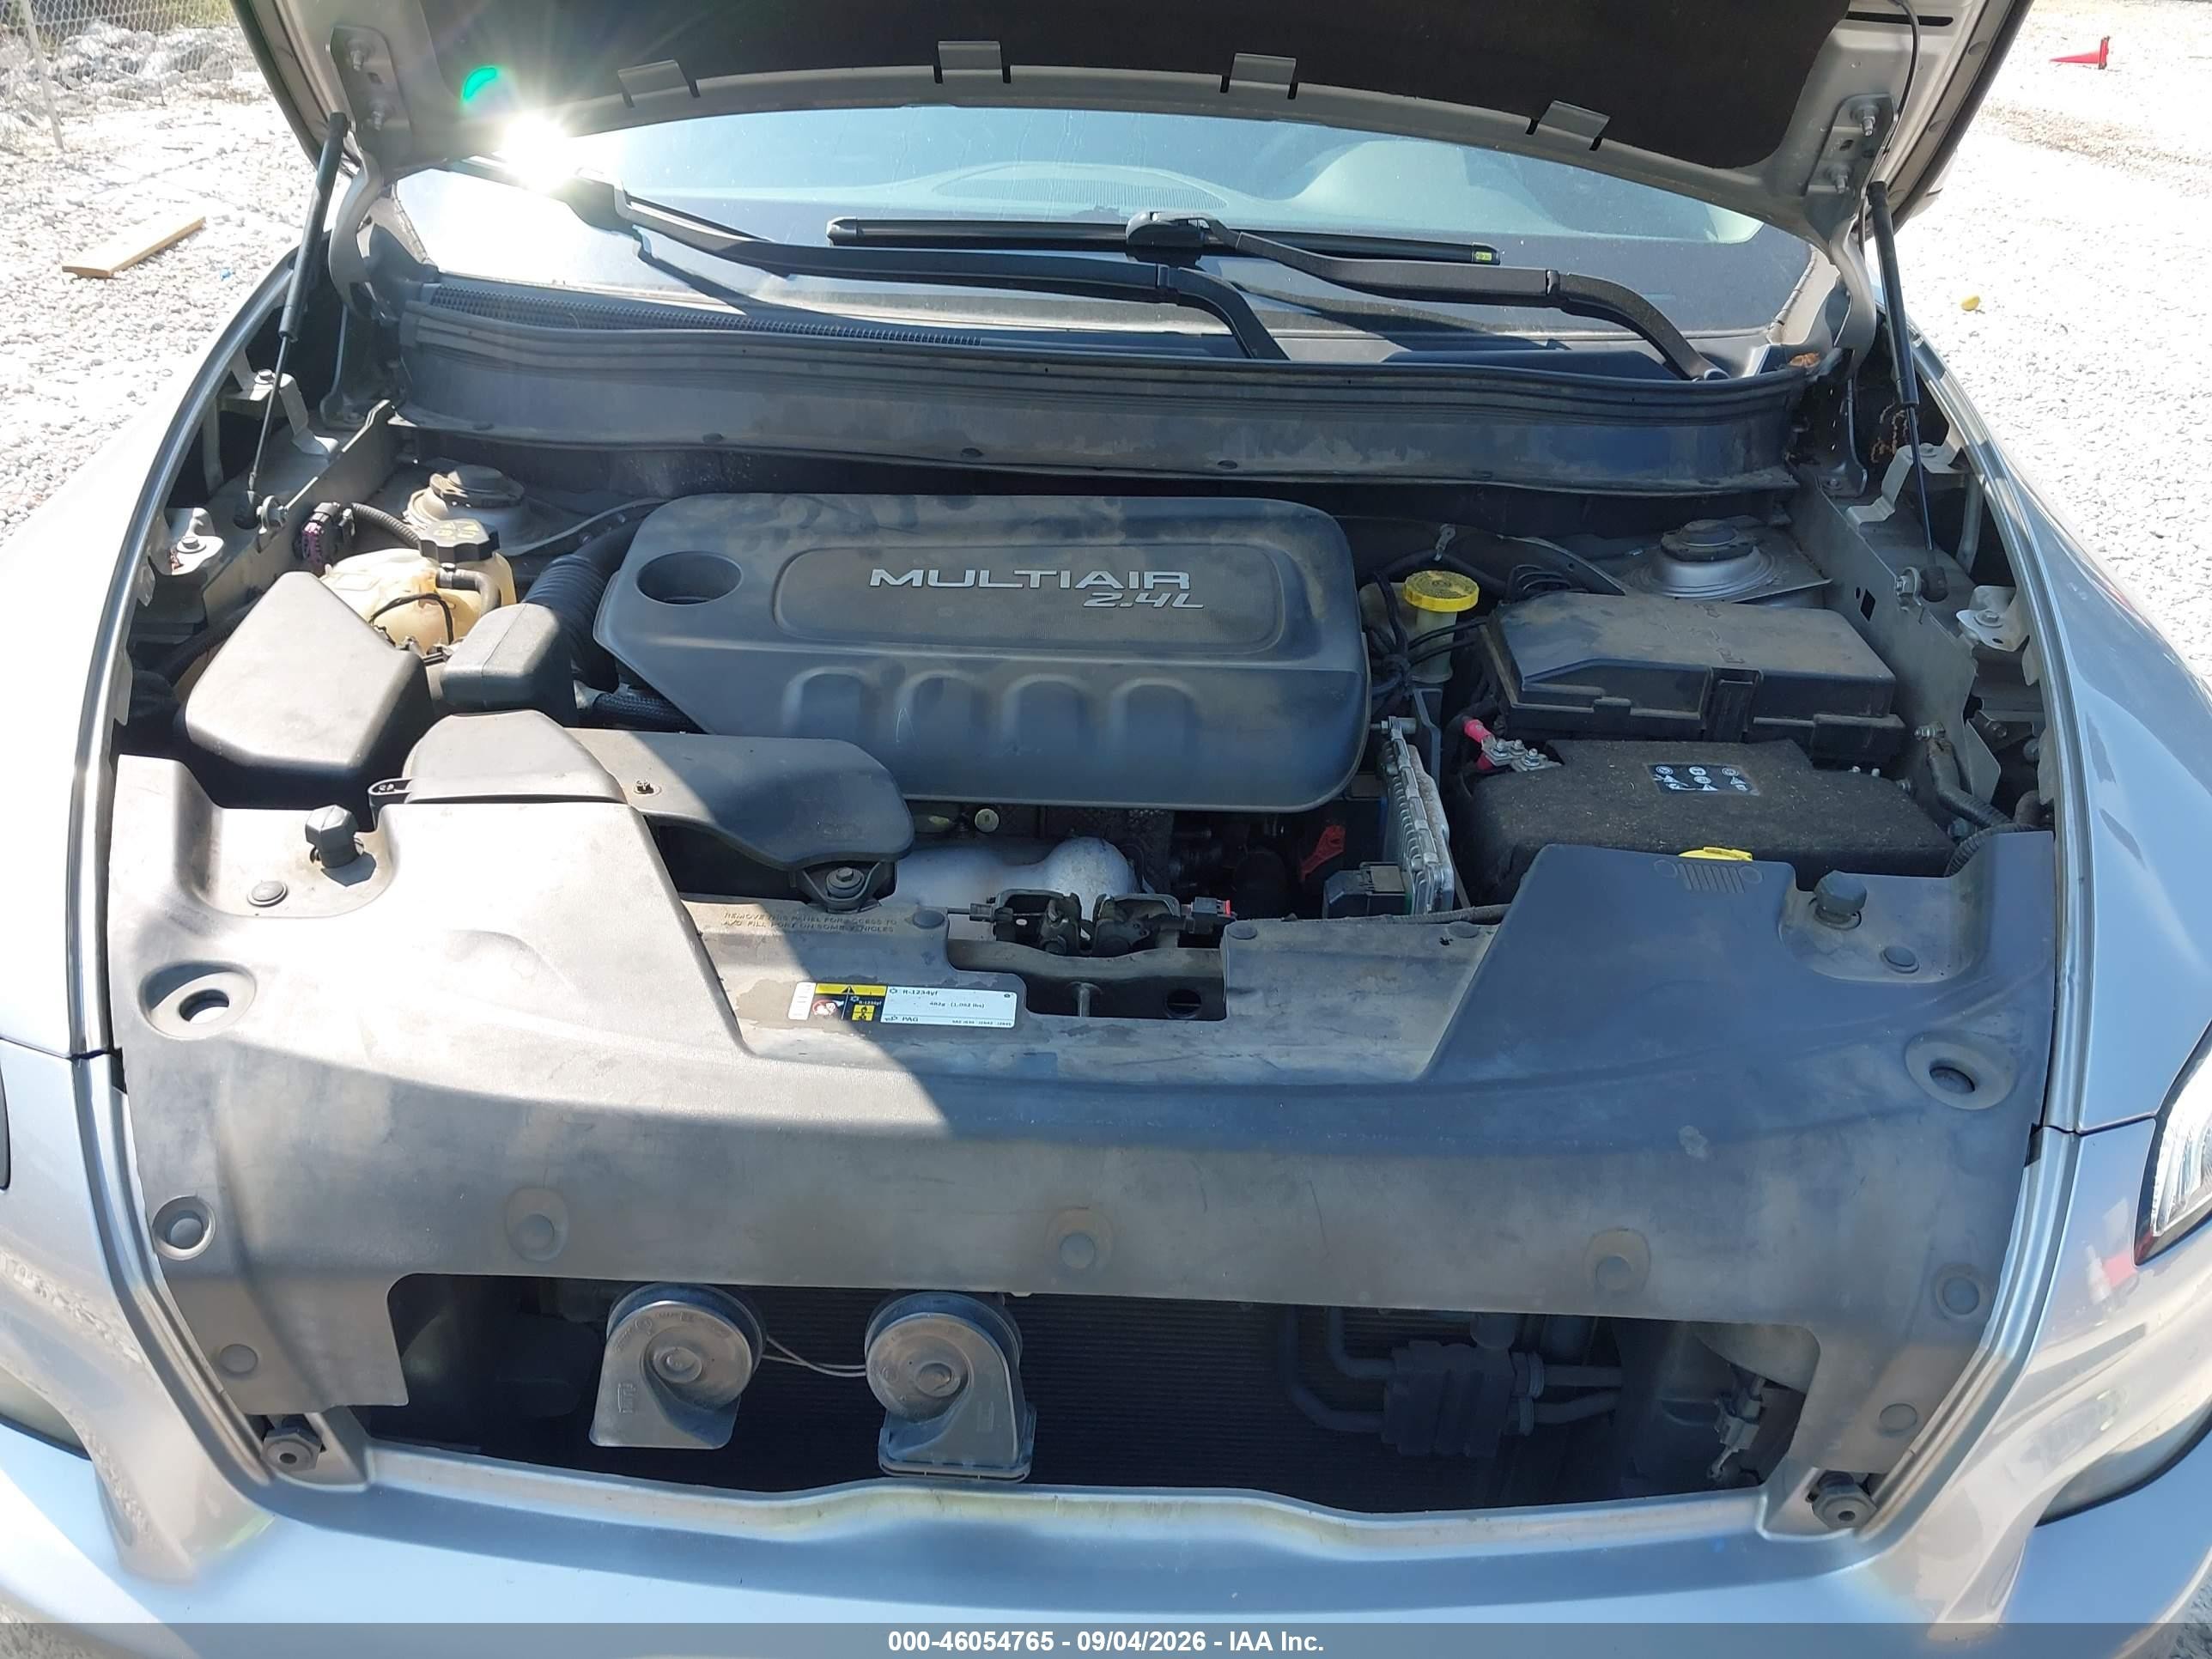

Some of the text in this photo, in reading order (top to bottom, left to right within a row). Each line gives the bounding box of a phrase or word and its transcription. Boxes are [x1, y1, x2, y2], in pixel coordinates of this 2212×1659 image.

[869, 568, 1191, 590] MULTIAIR
[1082, 592, 1205, 609] 2.4L
[724, 912, 766, 921] REMOVE
